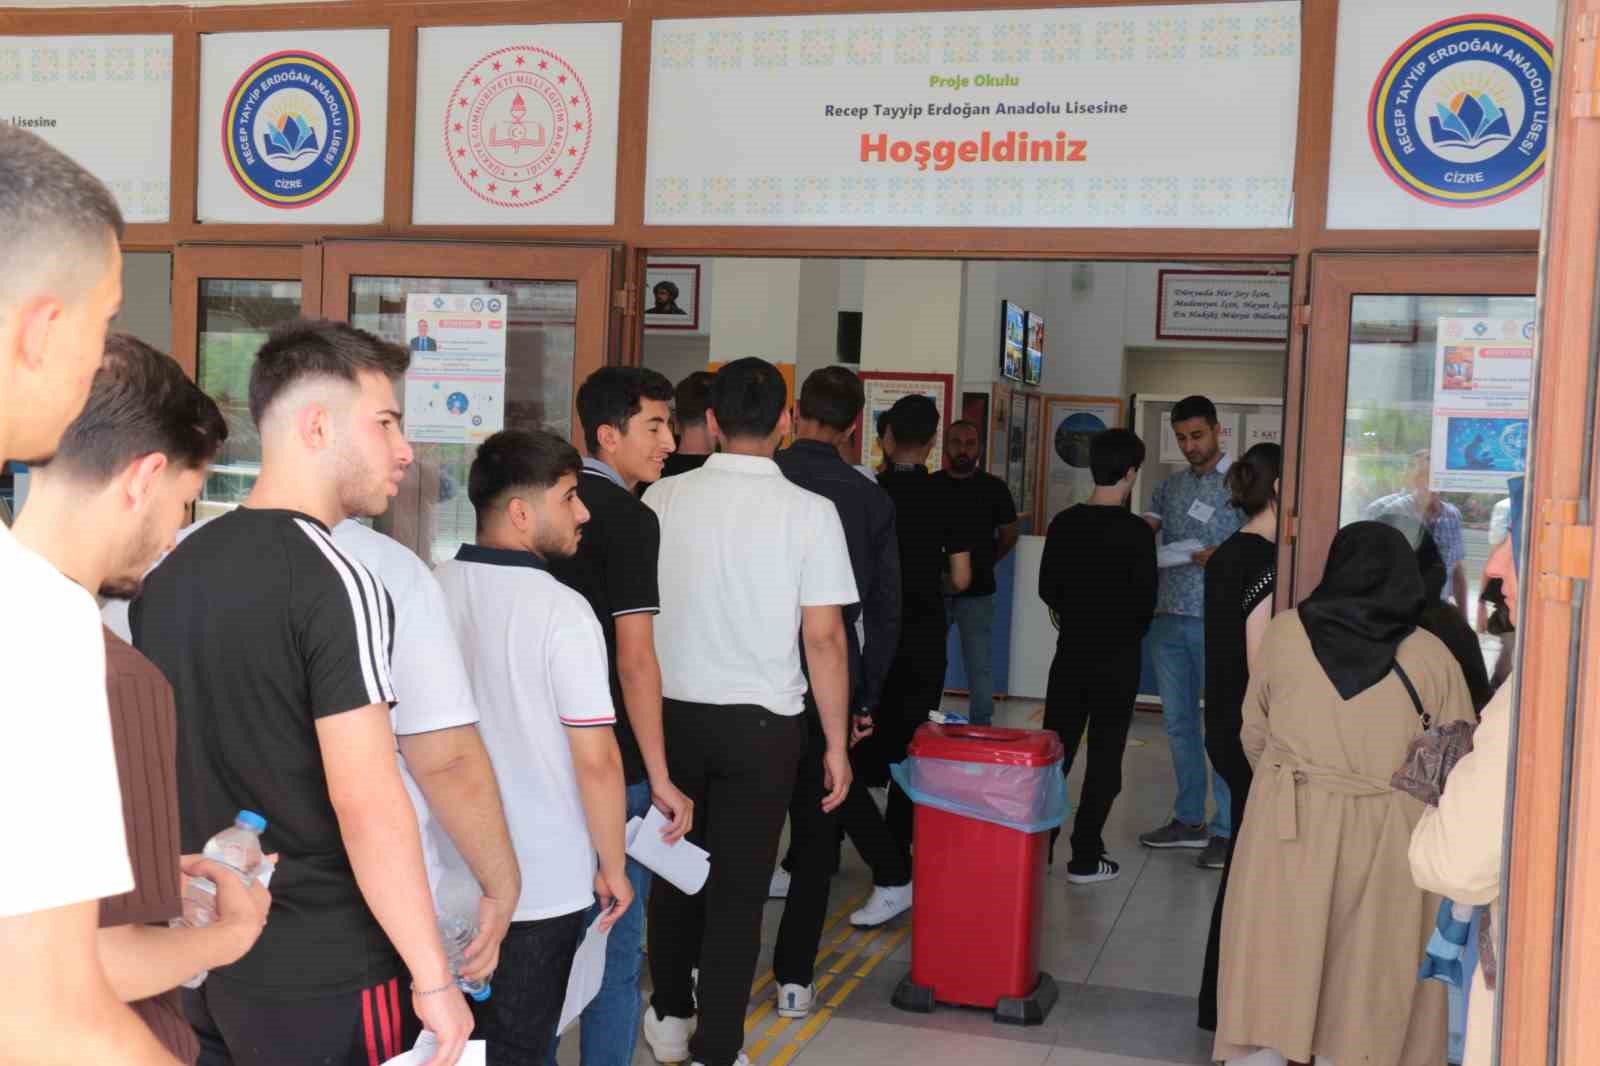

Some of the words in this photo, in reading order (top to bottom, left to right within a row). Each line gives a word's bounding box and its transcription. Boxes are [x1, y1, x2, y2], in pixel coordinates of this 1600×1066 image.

[1428, 38, 1503, 65] ERDOĞAN
[261, 68, 310, 92] ERDOĞAN
[929, 74, 968, 90] Proje
[974, 74, 1020, 87] Okulu
[1396, 61, 1427, 105] TAYYİP
[1503, 49, 1547, 107] ANADOLU
[240, 88, 262, 125] TAYYİP
[310, 78, 342, 126] ANADOLU
[825, 104, 869, 119] Recep
[872, 103, 922, 119] Tayyip
[927, 102, 991, 118] Erdoğan
[995, 101, 1060, 115] Anadolu
[1066, 100, 1128, 114] Lisesine
[239, 129, 256, 165] RECEP
[323, 129, 343, 166] LİSESİ
[859, 129, 1088, 171] Hoşgeldiniz
[1394, 110, 1416, 155] RECEP
[1518, 110, 1547, 156] LİSESİ
[274, 177, 303, 189] CİZRE
[1444, 171, 1485, 184] CİZRE
